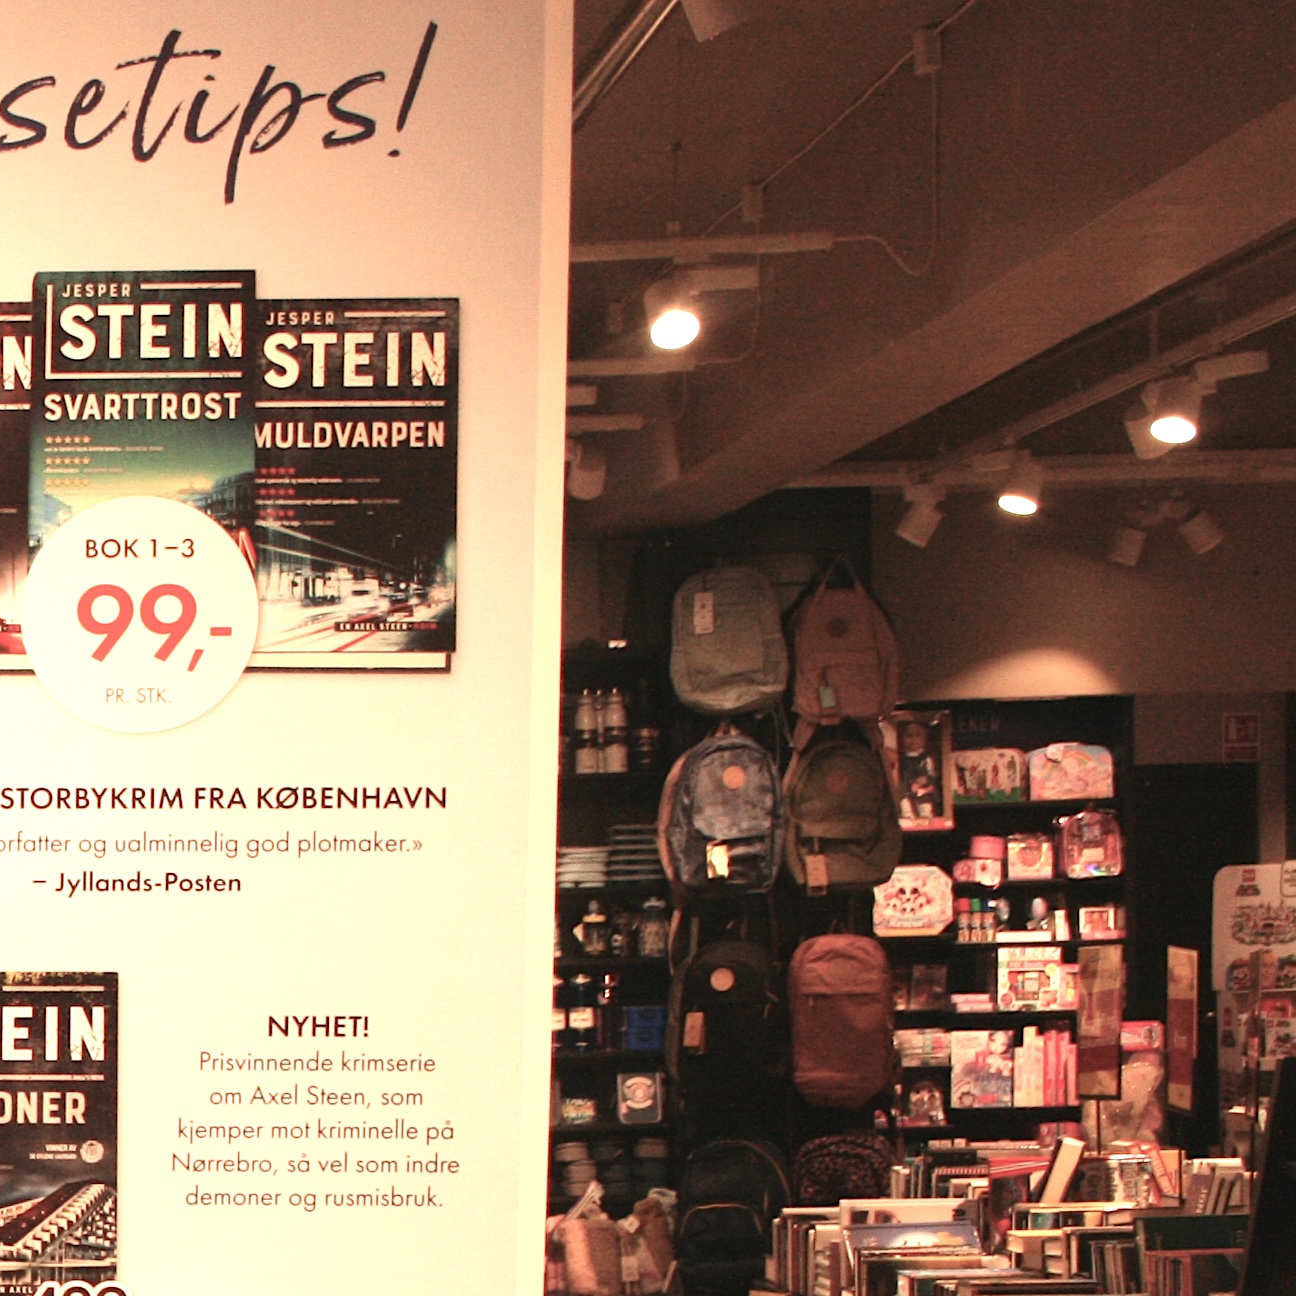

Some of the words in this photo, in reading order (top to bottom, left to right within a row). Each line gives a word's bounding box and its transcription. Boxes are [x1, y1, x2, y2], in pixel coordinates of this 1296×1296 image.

[59, 303, 243, 360] STEIN
[263, 331, 446, 388] STEIN
[44, 391, 242, 421] SVARTTROST
[255, 420, 445, 449] MULDVARPEN
[85, 538, 138, 559] BOK
[76, 583, 233, 672] 99,-
[106, 688, 130, 704] PR.
[137, 688, 172, 704] STK.
[0, 787, 184, 810] STORBYKRIM
[194, 787, 247, 809] FRA
[257, 786, 447, 810] KØBENHAVN
[78, 839, 106, 859] og
[115, 830, 238, 859] ualminnelig
[246, 830, 290, 859] god
[55, 870, 241, 898] Jyllands-Posten
[268, 1015, 369, 1038] NYHET!
[200, 1050, 333, 1072] Prisvinnende
[341, 1050, 436, 1073] krimserie
[209, 1092, 242, 1105] om
[249, 1083, 298, 1106] Axel
[306, 1085, 371, 1109] Steen,
[381, 1092, 423, 1106] som
[178, 1117, 264, 1145] kjemper
[271, 1122, 311, 1139] mot
[317, 1118, 418, 1140] kriminelle
[426, 1120, 454, 1146] på
[172, 1151, 278, 1176] Nørrebro,
[287, 1159, 310, 1173] så
[318, 1151, 348, 1173] vel
[355, 1160, 398, 1174] som
[406, 1152, 460, 1174] indre
[185, 1184, 282, 1206] demoner
[288, 1193, 317, 1213] og
[325, 1185, 443, 1207] rusmisbruk.
